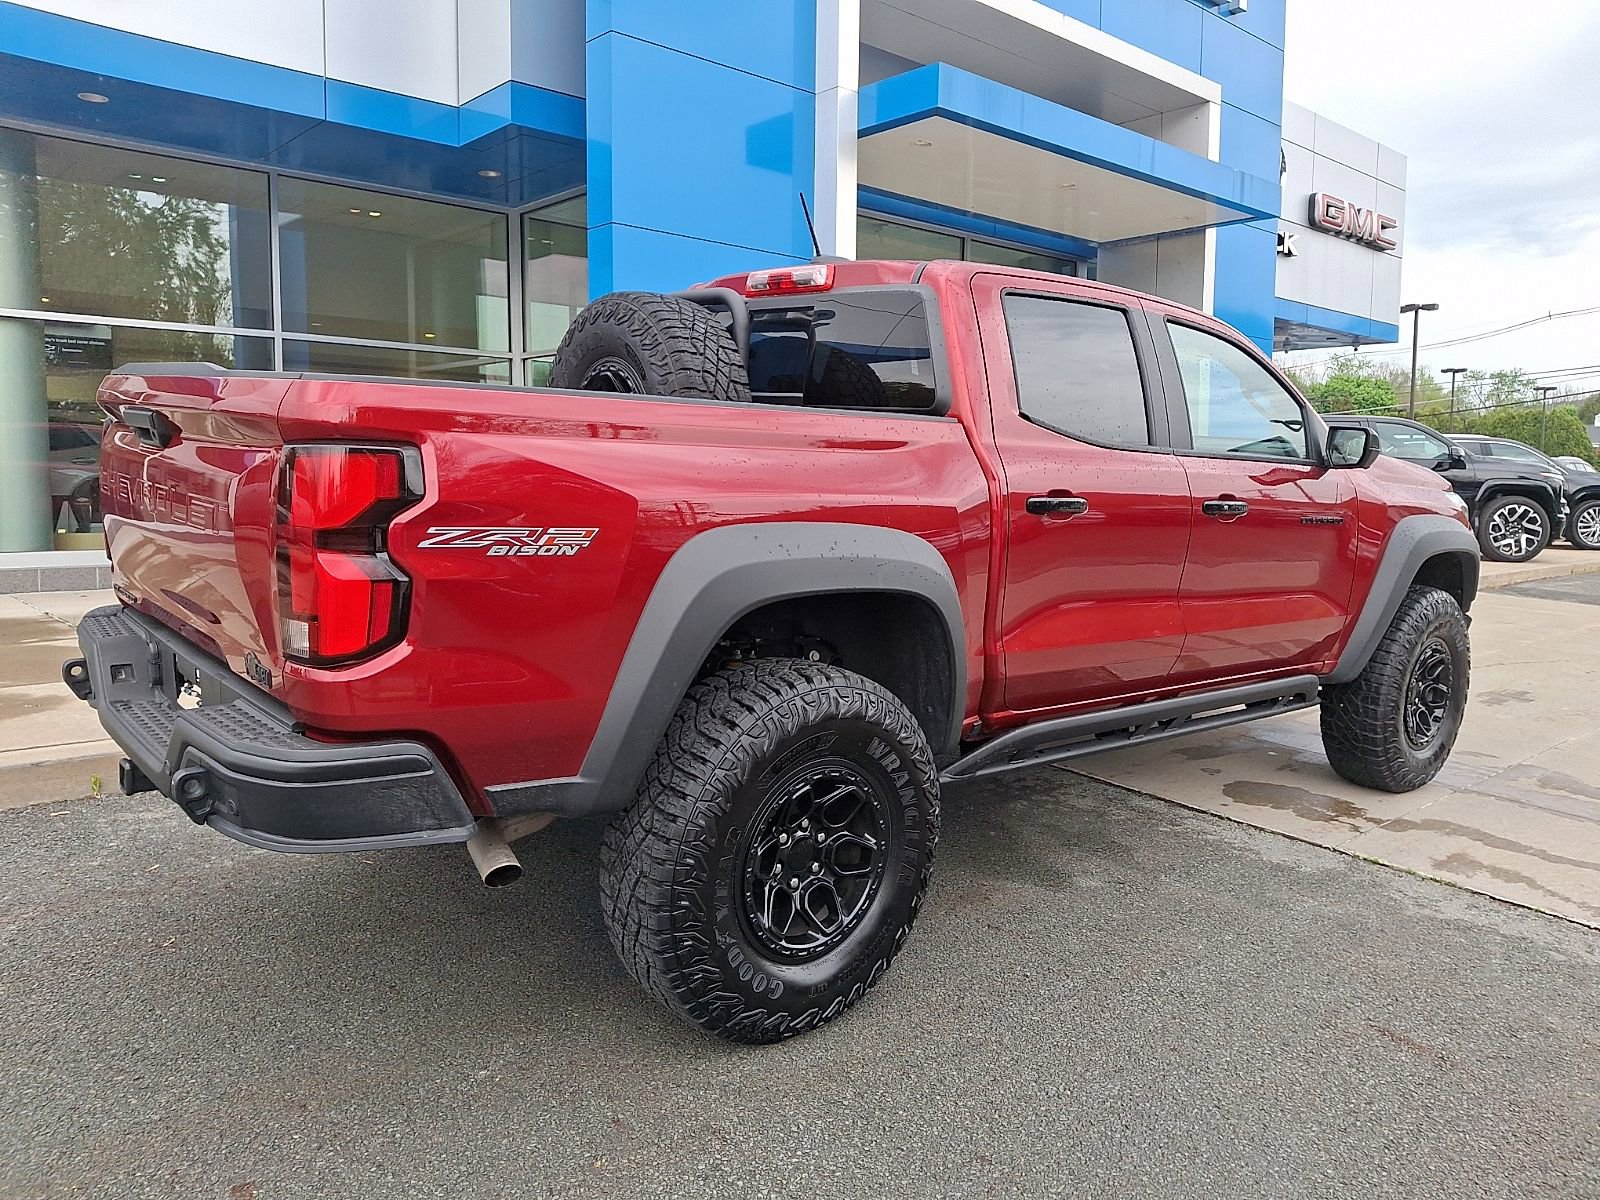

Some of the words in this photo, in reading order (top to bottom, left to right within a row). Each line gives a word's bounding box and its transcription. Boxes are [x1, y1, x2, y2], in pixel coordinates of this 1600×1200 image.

[1311, 192, 1398, 250] GMC
[100, 467, 228, 535] CHEVROLET
[417, 526, 599, 548] ZR2
[486, 544, 581, 557] BISON
[865, 736, 921, 886] WRANGLER
